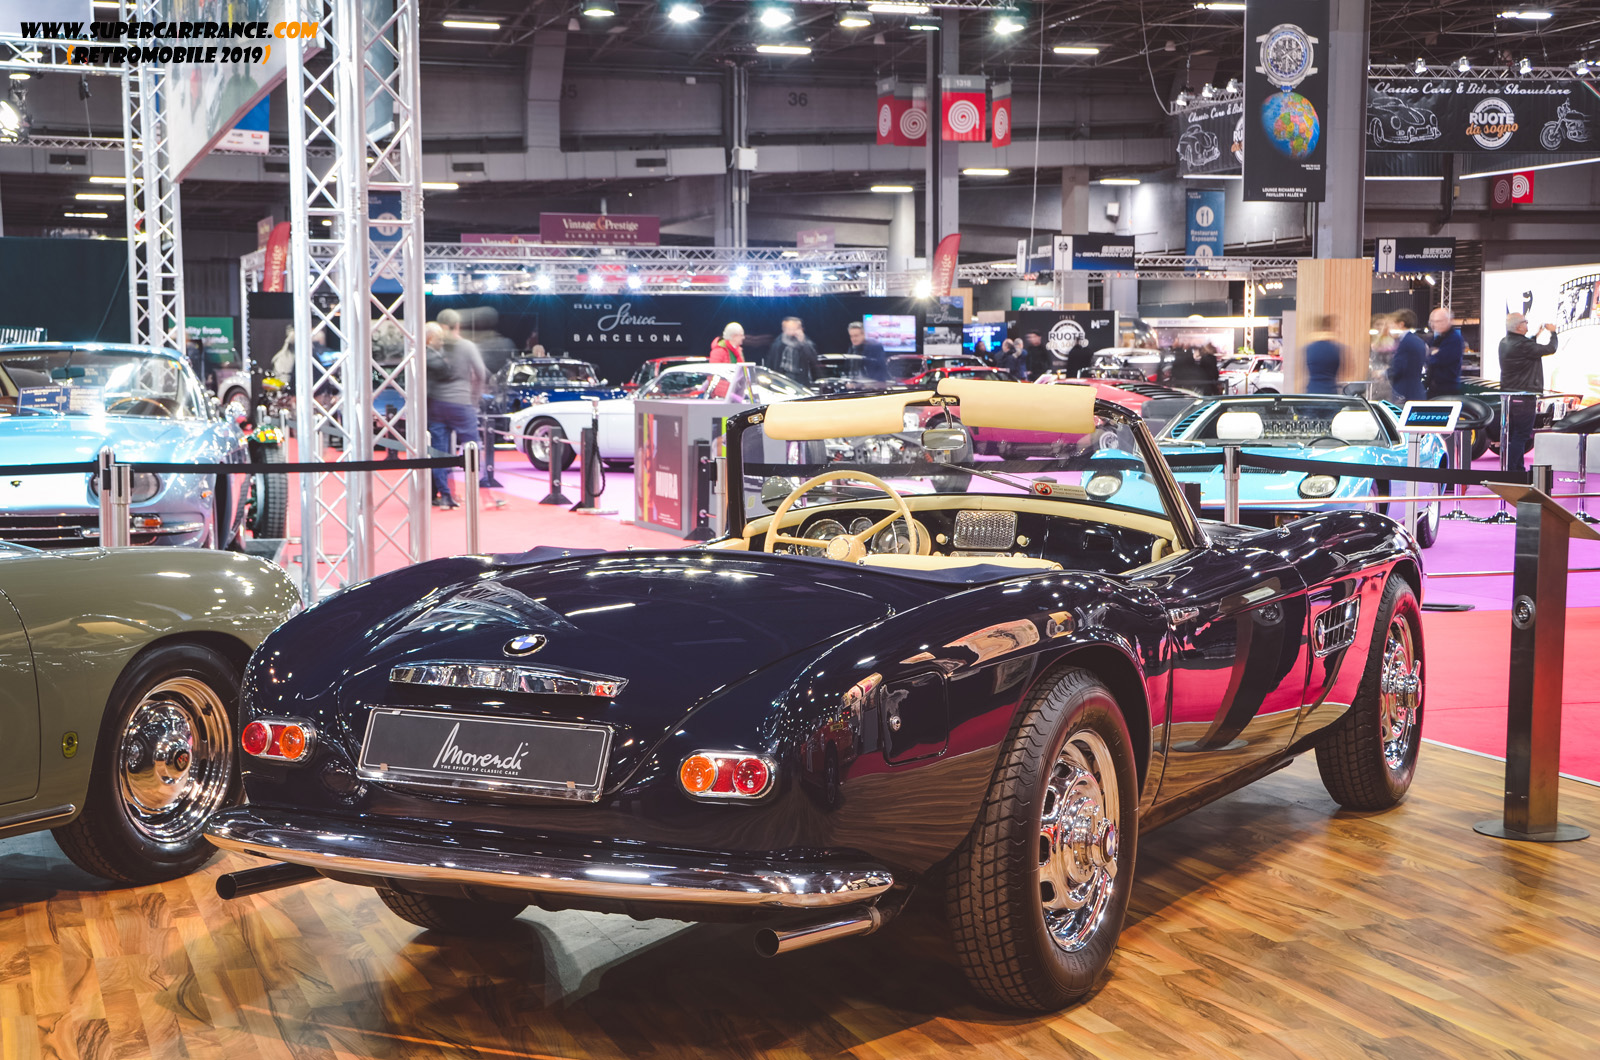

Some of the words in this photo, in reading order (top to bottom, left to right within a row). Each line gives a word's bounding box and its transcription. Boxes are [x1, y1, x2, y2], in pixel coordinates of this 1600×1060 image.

[1374, 81, 1420, 94] Classic
[788, 91, 808, 107] 36
[1468, 111, 1515, 125] RUOTE
[1465, 122, 1482, 136] da
[1483, 122, 1519, 138] sogno
[562, 218, 597, 232] Vintage
[604, 219, 639, 232] Prestige
[573, 333, 683, 343] BARCELONA
[1049, 332, 1085, 341] RUOTE
[1408, 412, 1449, 421] KIDSTON
[432, 722, 529, 770] Movendi
